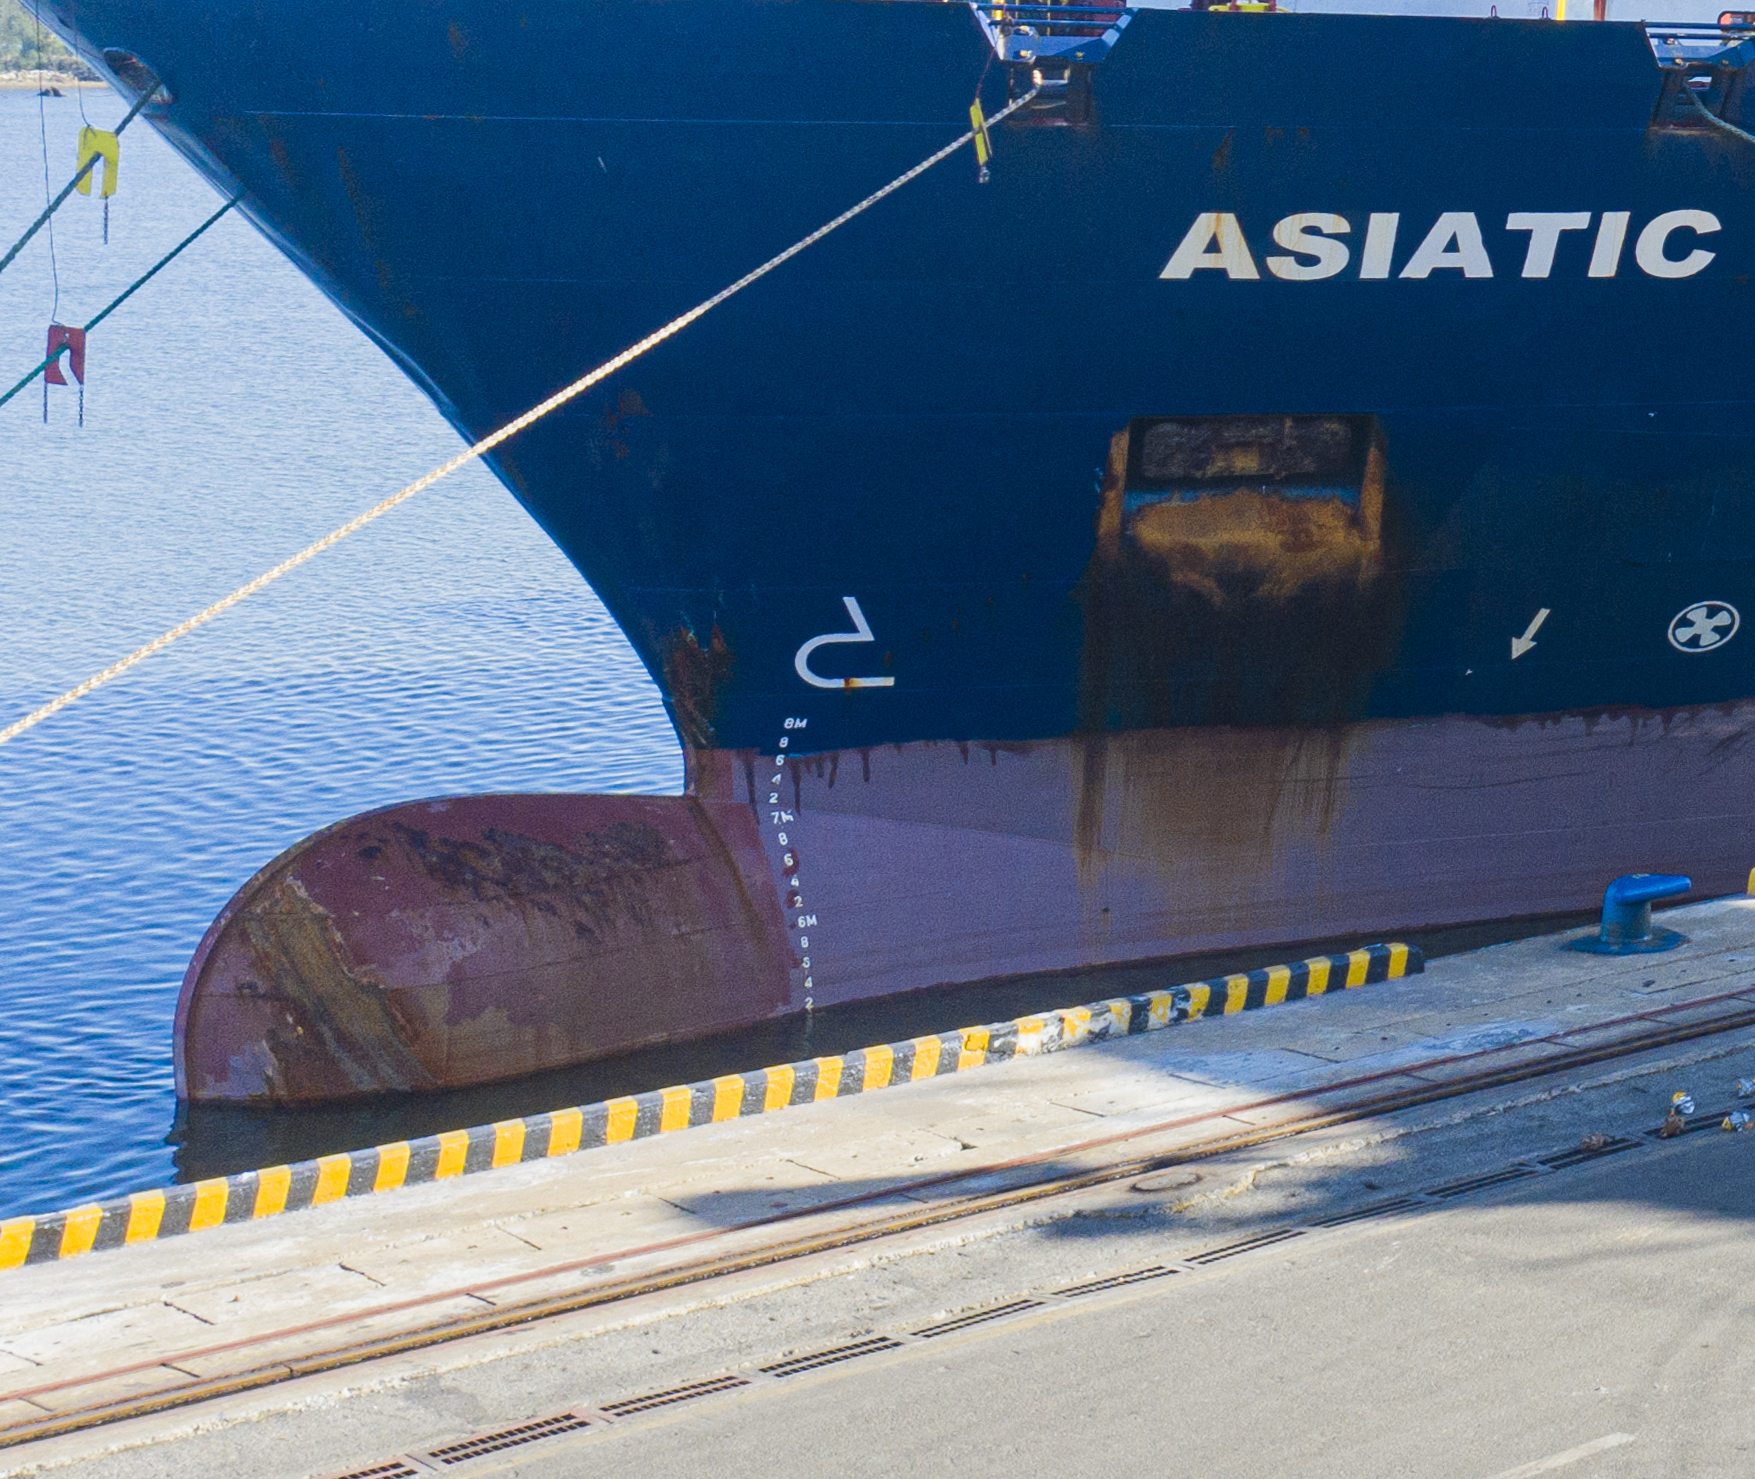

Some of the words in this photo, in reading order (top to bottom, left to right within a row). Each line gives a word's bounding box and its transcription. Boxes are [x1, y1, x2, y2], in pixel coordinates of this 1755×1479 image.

[1159, 209, 1721, 281] ASIATIC
[784, 718, 808, 729] 8M
[779, 737, 789, 748] 8
[775, 755, 785, 766] 6
[771, 774, 781, 785] 4
[769, 793, 778, 804] 2
[772, 811, 794, 823] 7M
[779, 832, 789, 845] 8
[784, 854, 793, 866] 6
[790, 875, 799, 887] 4
[794, 896, 803, 908] 2
[797, 915, 817, 927] 6M
[800, 936, 809, 948] 8
[803, 977, 812, 989] 4
[805, 997, 814, 1009] 2
